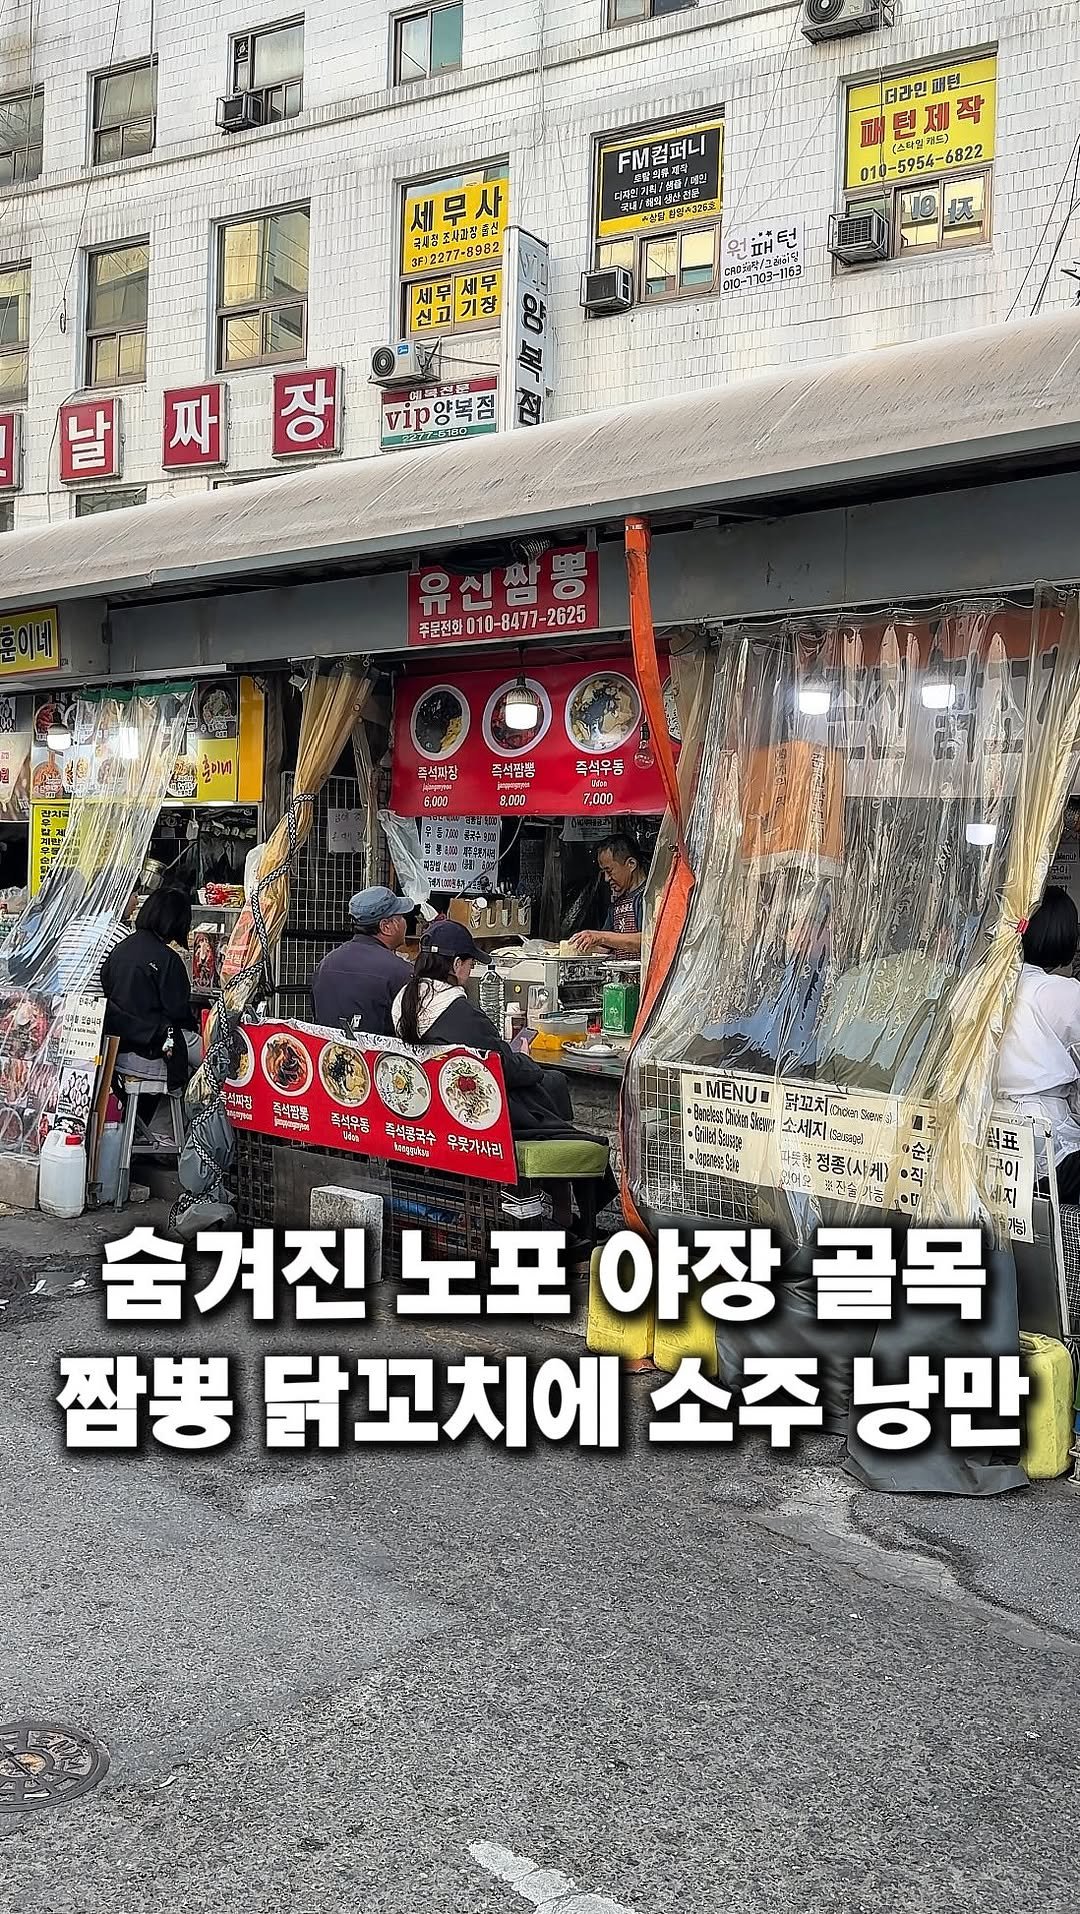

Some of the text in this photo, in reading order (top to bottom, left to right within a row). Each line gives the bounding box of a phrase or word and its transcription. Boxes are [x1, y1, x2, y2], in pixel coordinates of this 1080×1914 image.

[884, 73, 961, 105] 더라인 패턴
[618, 134, 705, 173] FM컴퍼니
[892, 133, 949, 154] (스타일 캐드)
[633, 163, 689, 184] 토탈 의류 제작
[860, 144, 983, 181] 010-5954-6822
[614, 187, 639, 201] 디자인
[640, 184, 657, 197] 기획
[690, 173, 707, 185] 메인
[410, 185, 503, 233] 세무사
[620, 200, 638, 213] 국내
[645, 196, 662, 208] 해외
[664, 192, 681, 204] 생산
[682, 187, 700, 200] 전문
[413, 221, 499, 250] 국세청 조사과장 출신
[727, 228, 798, 260] 원패턴
[460, 273, 497, 296] 세무
[723, 265, 802, 291] 010-7703-1163
[416, 283, 451, 305] 세무
[460, 295, 498, 317] 기장
[416, 306, 451, 327] 신고
[517, 292, 547, 427] 양복점
[385, 394, 496, 432] vip양복점
[401, 427, 468, 443] 2277-5180
[419, 551, 589, 617] 유신짬뽕
[419, 604, 586, 639] 주문전화 010-8477-2625
[0, 619, 53, 664] 훈이네
[417, 764, 459, 781] 즉석짜장
[491, 761, 536, 779] 즉석짬뽕
[575, 759, 625, 776] 즉석우동
[591, 779, 608, 788] Udon
[423, 795, 449, 808] 6,000
[499, 794, 526, 807] 8,000
[583, 792, 614, 807] 7,000
[219, 1090, 253, 1110] 즉석짜장
[706, 1080, 758, 1104] MENU
[272, 1101, 310, 1122] 즉석짬뽕
[725, 1107, 749, 1129] Chicken
[785, 1092, 829, 1116] 닭꼬치
[829, 1103, 859, 1120] (Chicken
[331, 1111, 370, 1134] 즉석우동
[384, 1121, 437, 1147] 즉석콩국수
[781, 1116, 864, 1145] 소세지 (Sausage)
[342, 1130, 360, 1143] Udon
[447, 1133, 504, 1160] 우뭇가사리
[694, 1124, 743, 1151] Grilled Sausage
[694, 1147, 740, 1174] Japanese Sake
[816, 1152, 889, 1183] 정종(사케)
[835, 1179, 858, 1198] 잔술
[862, 1185, 884, 1203] 가능
